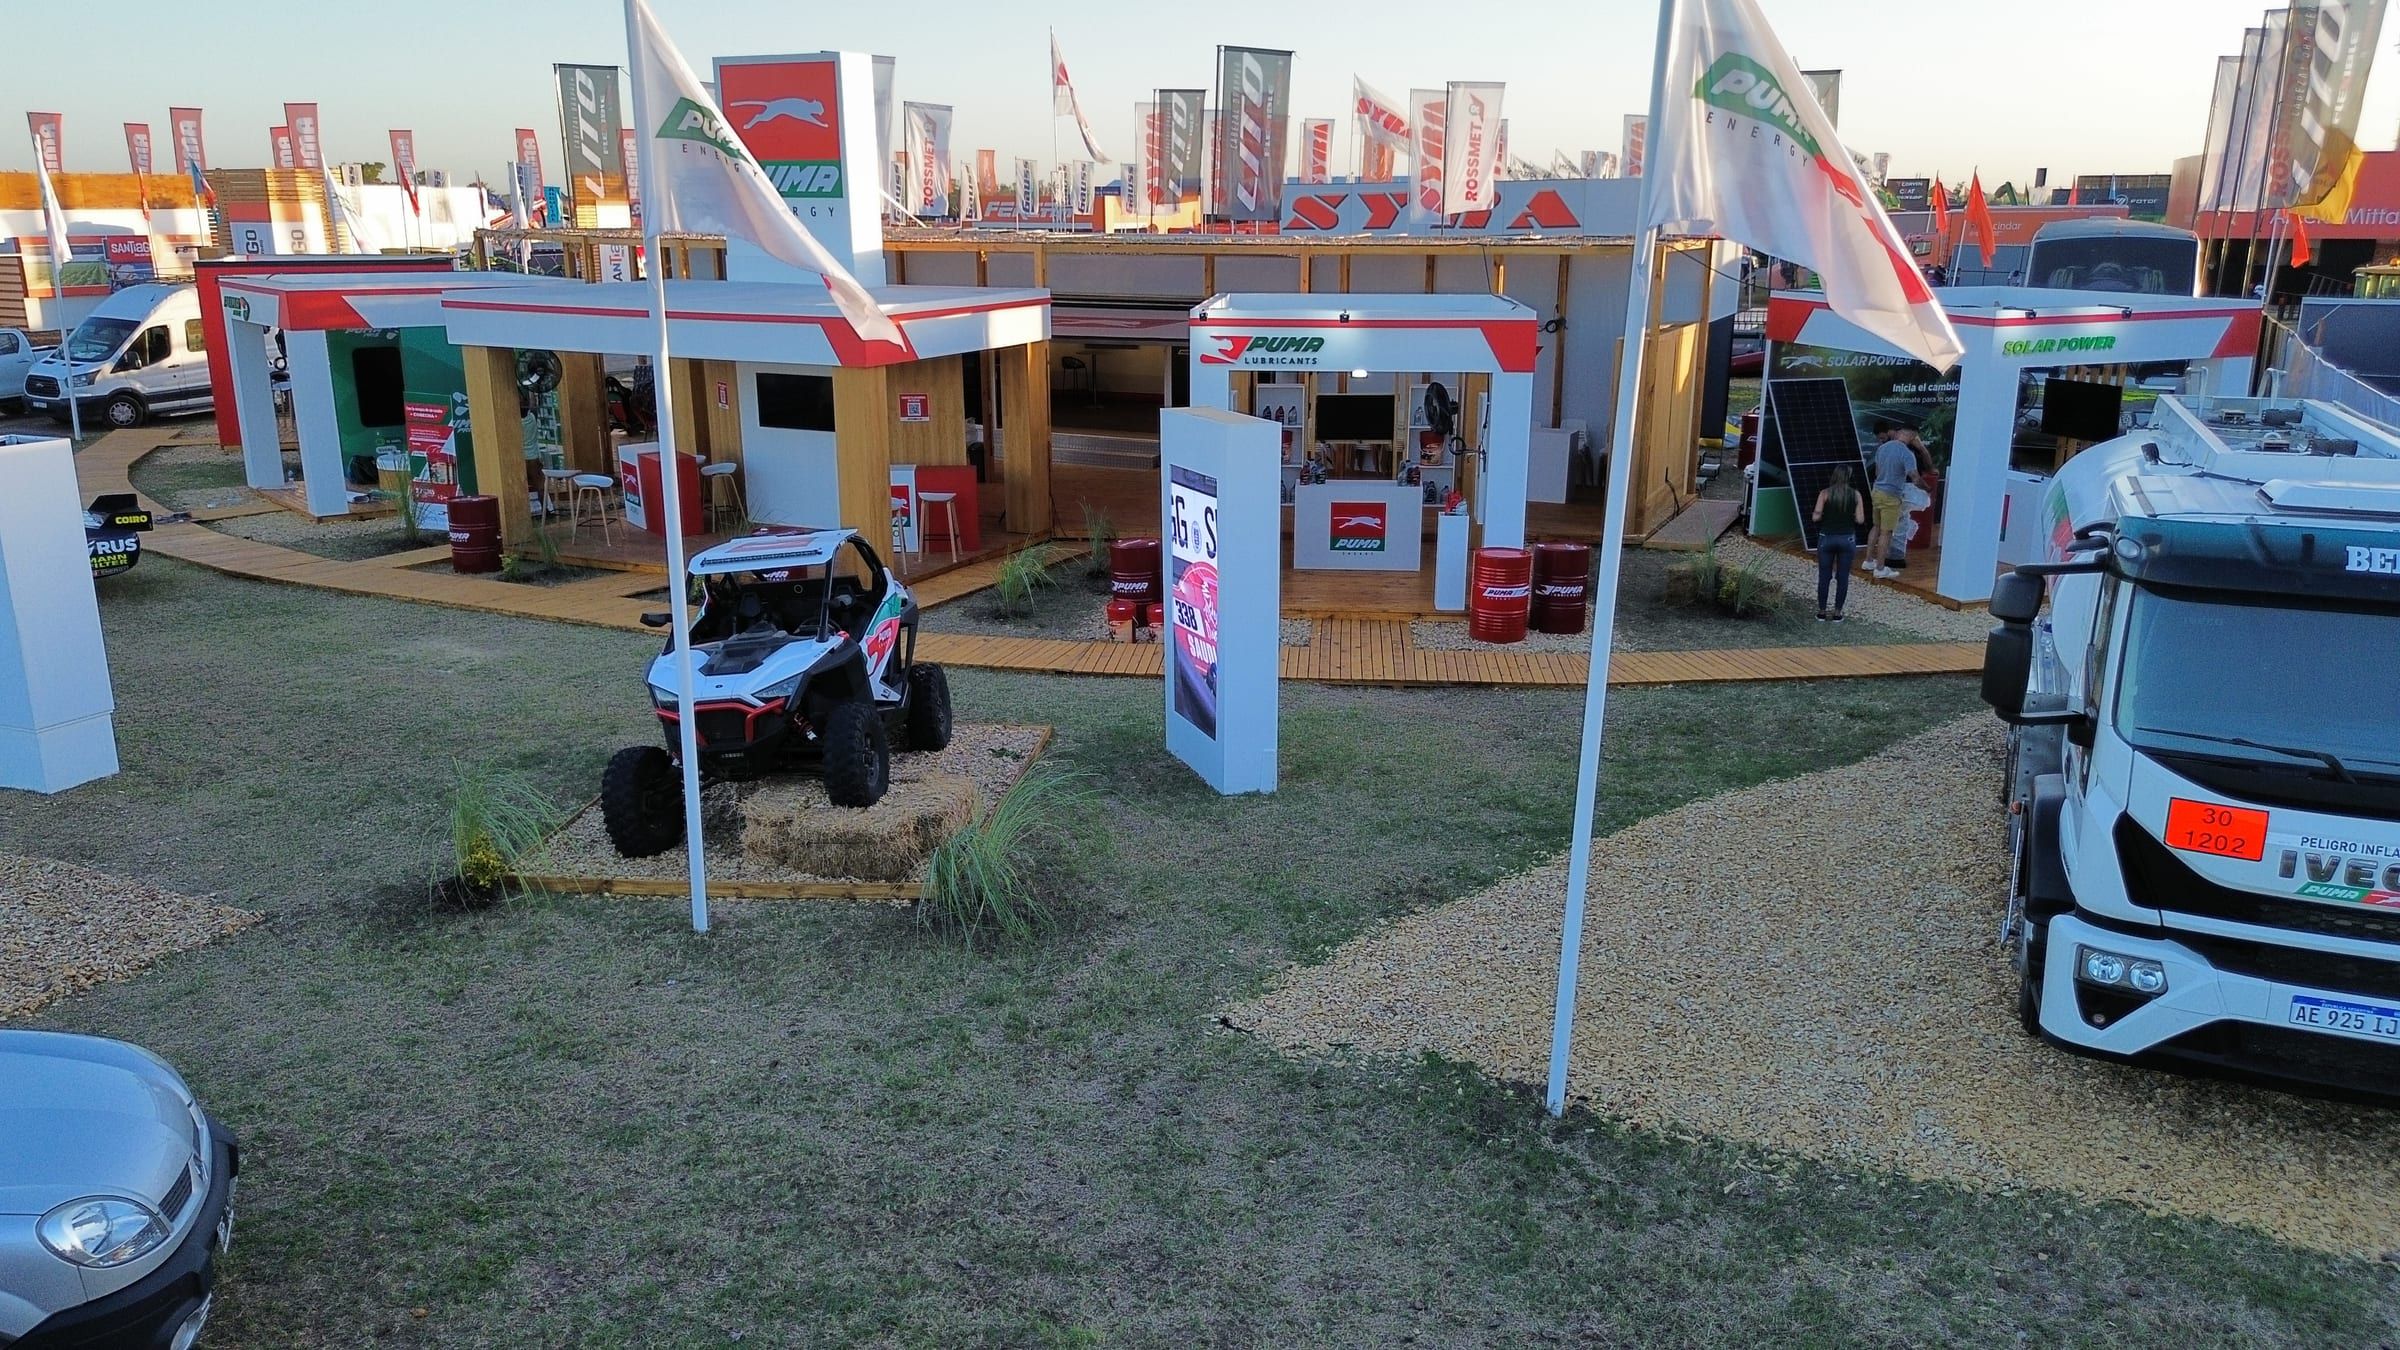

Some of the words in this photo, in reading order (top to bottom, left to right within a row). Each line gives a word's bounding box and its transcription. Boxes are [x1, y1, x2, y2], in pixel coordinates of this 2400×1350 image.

[575, 68, 606, 199] LITO
[1236, 52, 1263, 212] LITO
[1706, 111, 1809, 168] ENERGY
[1167, 92, 1187, 198] LITO
[1419, 100, 1445, 214] SYRA
[1465, 121, 1483, 202] ROSSMET
[764, 165, 840, 193] UMA
[923, 138, 936, 207] ROSSMET
[1246, 336, 1325, 353] PUMA
[2002, 339, 2056, 355] SOLAR
[2057, 336, 2116, 353] POWER
[1244, 356, 1318, 365] LUBRICANTS
[1826, 356, 1867, 367] SOLAR
[1870, 357, 1912, 366] POWER
[1892, 383, 1916, 393] Inicia
[1918, 382, 1926, 392] el
[1928, 382, 1960, 392] cambio
[115, 514, 148, 525] COIRO
[1334, 538, 1381, 549] PUMA
[1116, 581, 1149, 591] PUMA
[1552, 585, 1584, 594] PUMA
[1175, 599, 1198, 632] 338
[2202, 807, 2233, 827] 30
[2184, 829, 2246, 855] 1202
[2300, 836, 2358, 853] PELIGRO
[2303, 885, 2360, 899] PUMA
[2295, 1005, 2321, 1023] AE
[2327, 1010, 2366, 1030] 925
[2372, 1016, 2398, 1035] IJ
